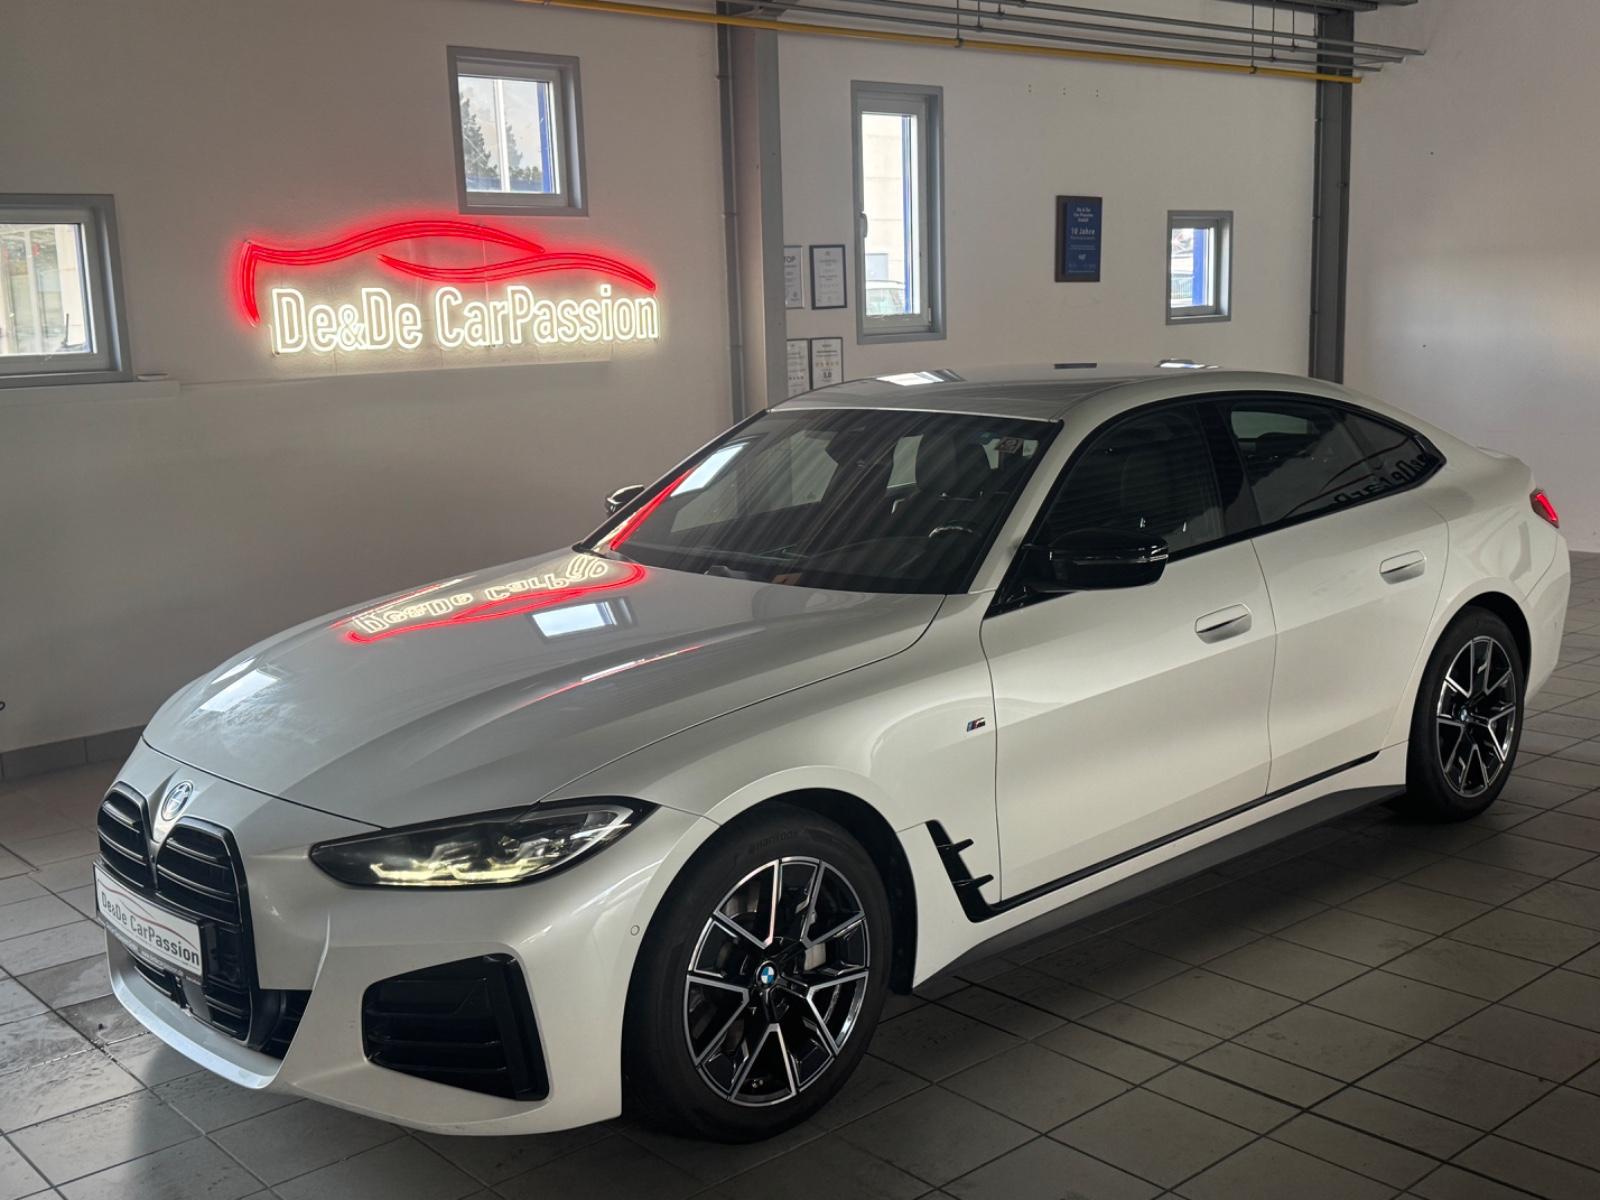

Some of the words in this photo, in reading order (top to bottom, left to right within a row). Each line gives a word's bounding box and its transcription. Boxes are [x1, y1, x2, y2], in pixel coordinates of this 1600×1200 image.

[271, 287, 423, 353] De&De
[435, 284, 659, 347] CarPassion
[101, 891, 128, 925] De&De
[129, 915, 200, 966] CarPassion
